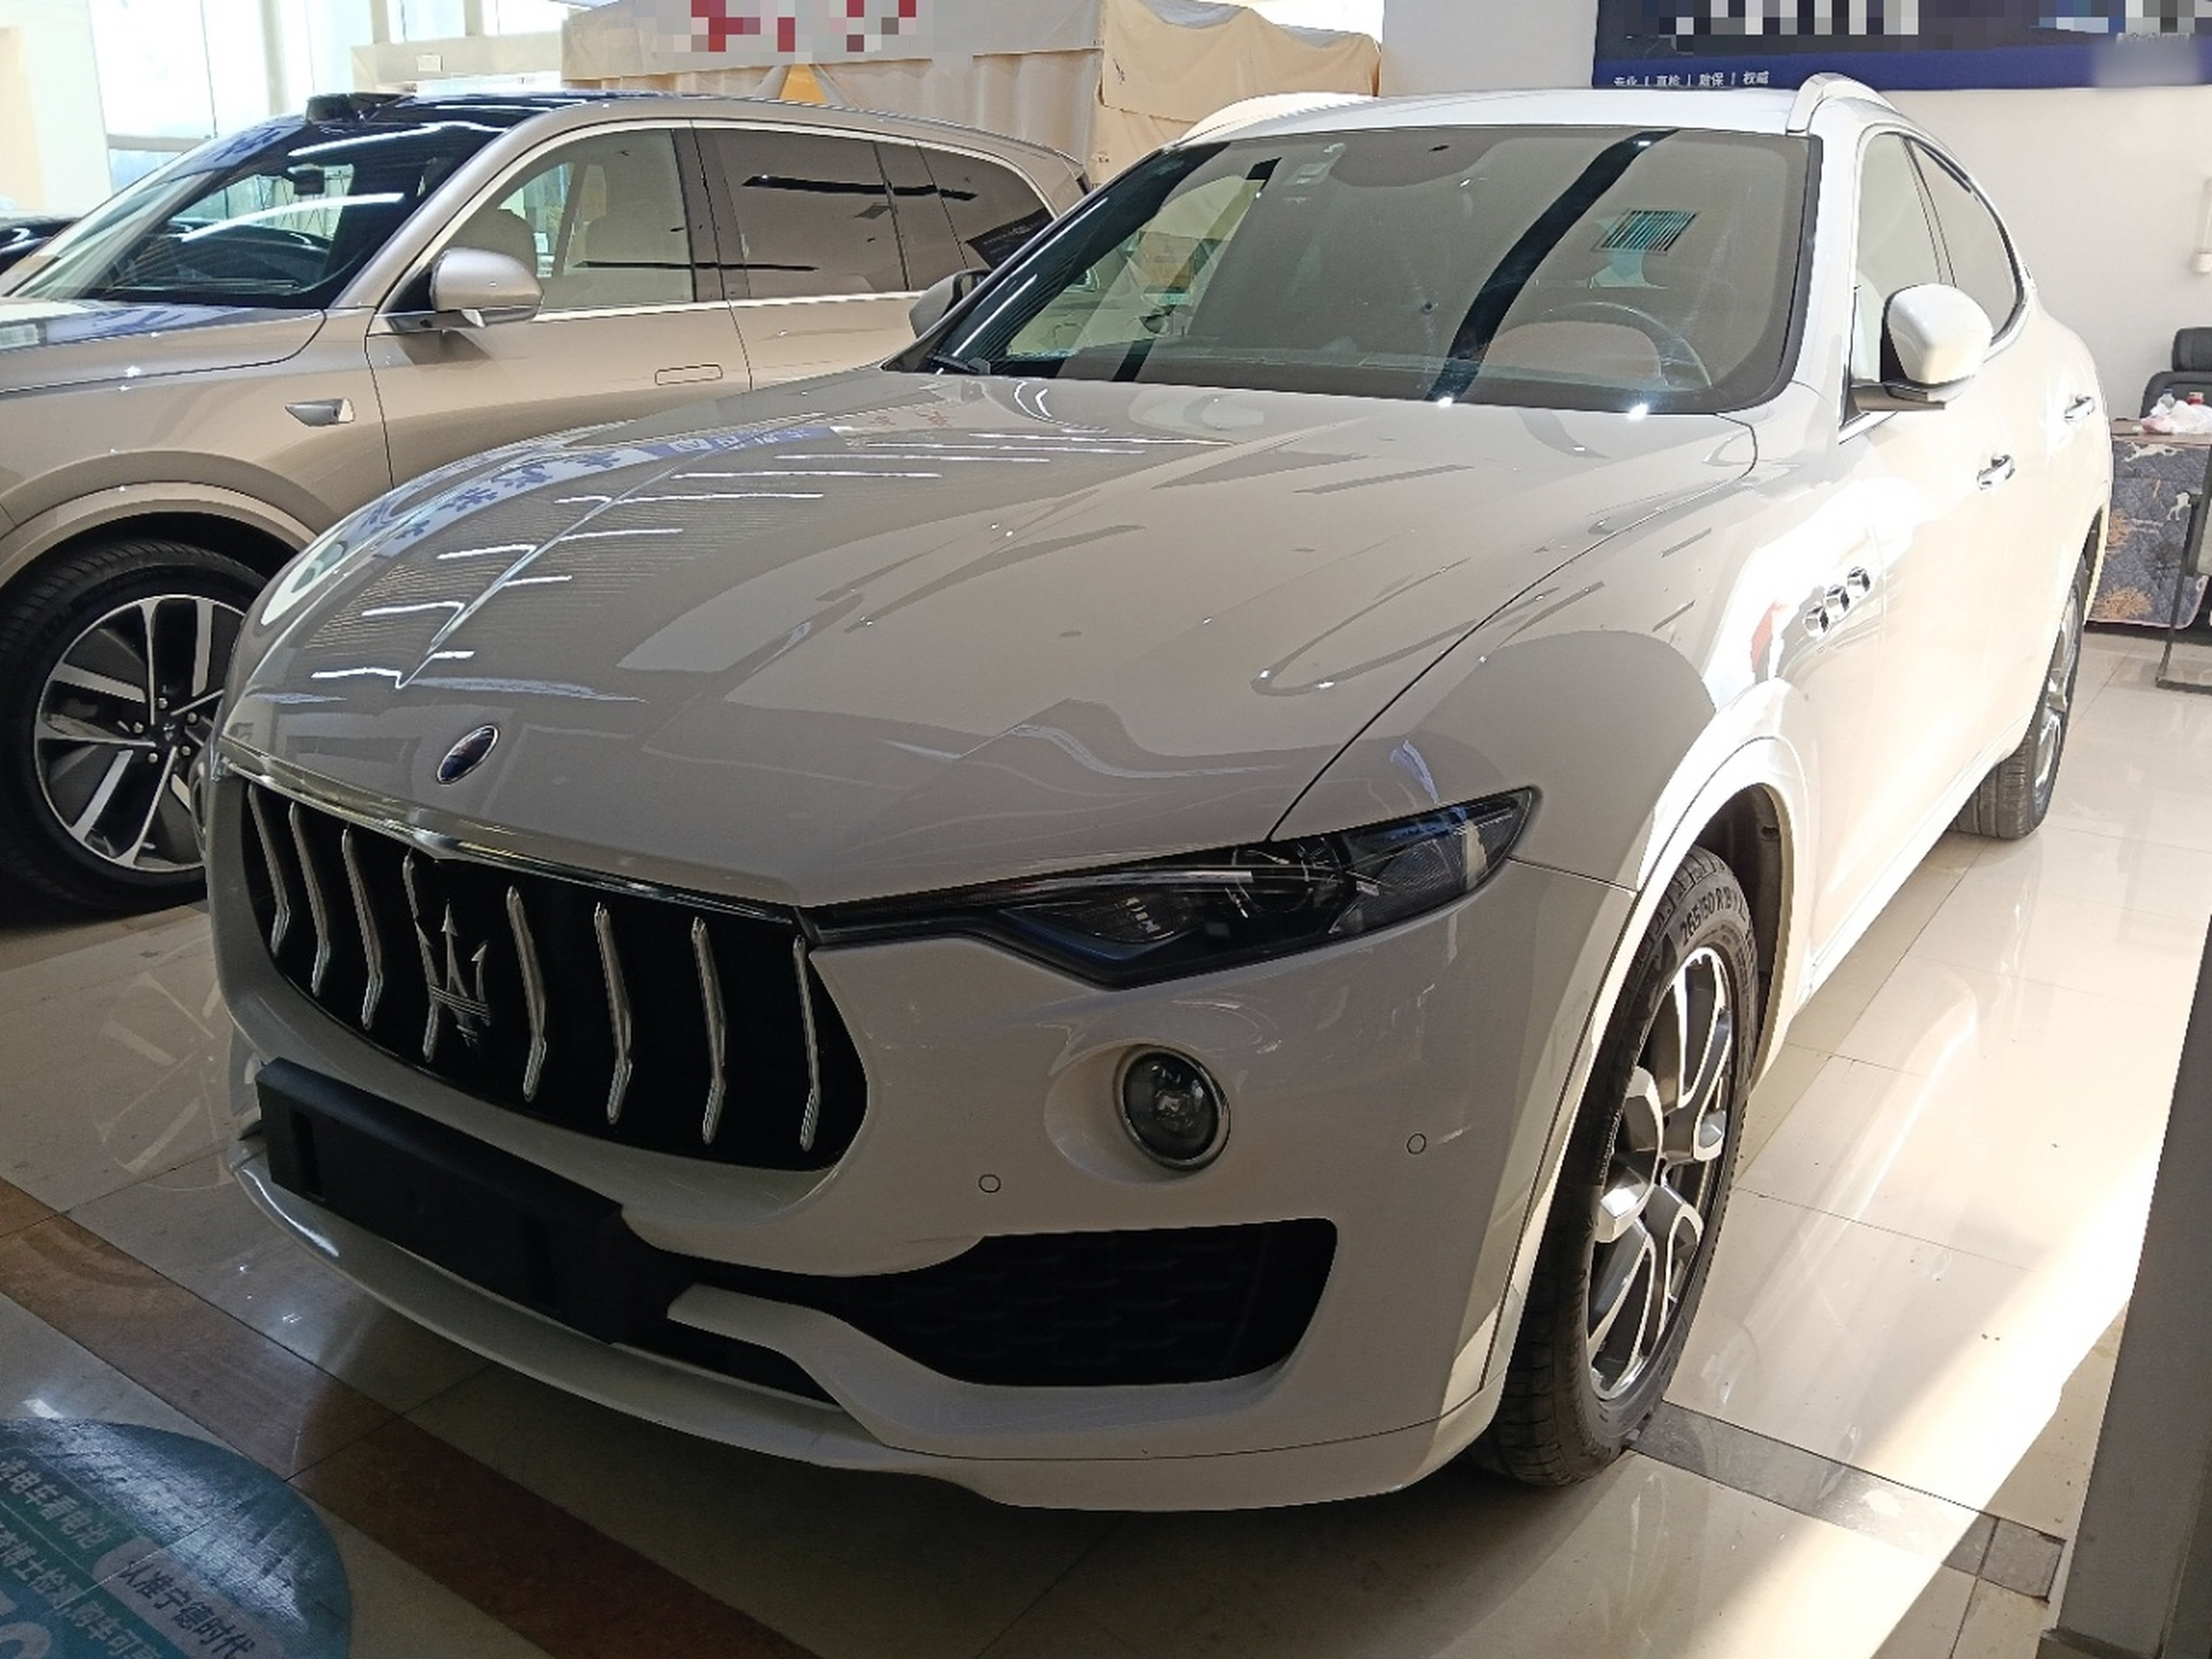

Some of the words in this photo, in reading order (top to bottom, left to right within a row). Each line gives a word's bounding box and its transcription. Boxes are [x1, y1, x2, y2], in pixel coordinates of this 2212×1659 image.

[1743, 70, 1769, 85] 权威
[118, 1560, 256, 1659] 认准宁德时代
